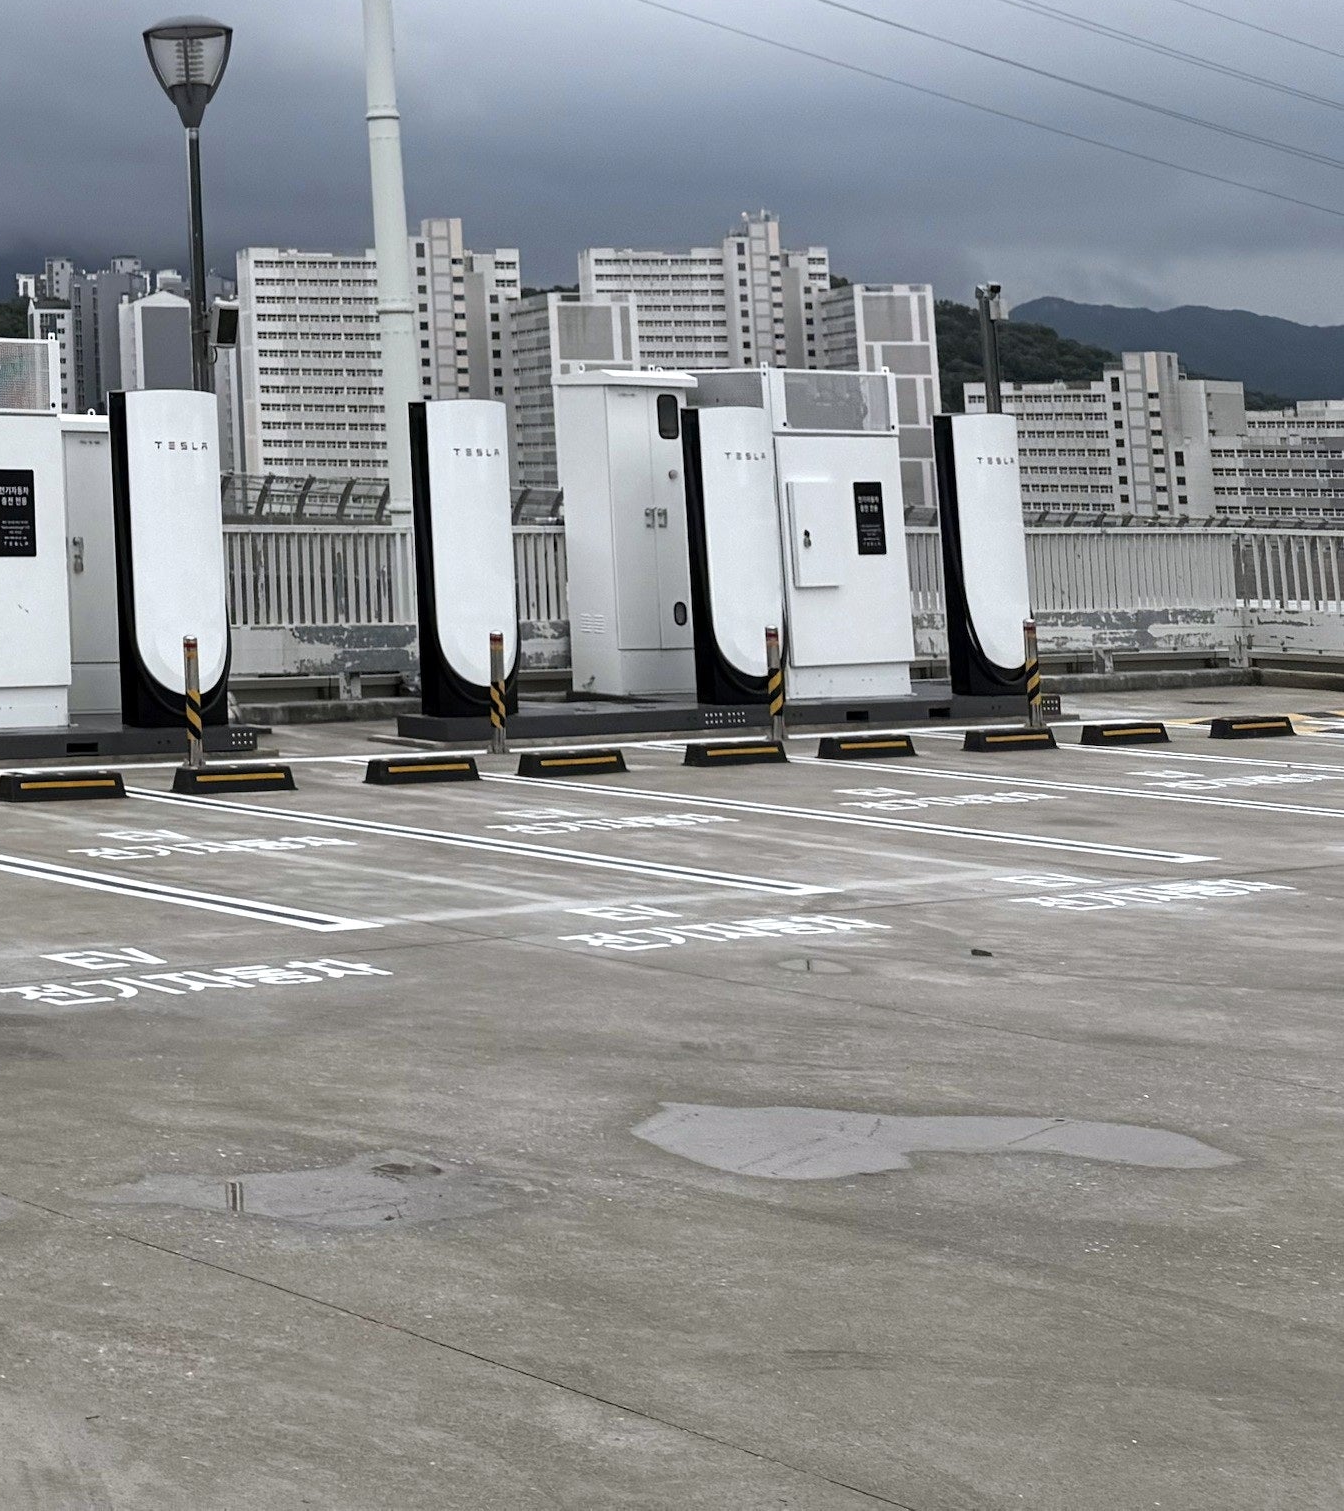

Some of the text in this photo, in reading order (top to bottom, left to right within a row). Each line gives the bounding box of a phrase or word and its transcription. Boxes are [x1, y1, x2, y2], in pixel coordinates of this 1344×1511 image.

[154, 440, 208, 451] TESLA
[452, 448, 500, 458] TESLA
[724, 451, 767, 461] TESLA
[976, 456, 1015, 466] TESLA
[97, 829, 193, 842] EV
[563, 903, 683, 921] EV
[38, 948, 168, 970] EV
